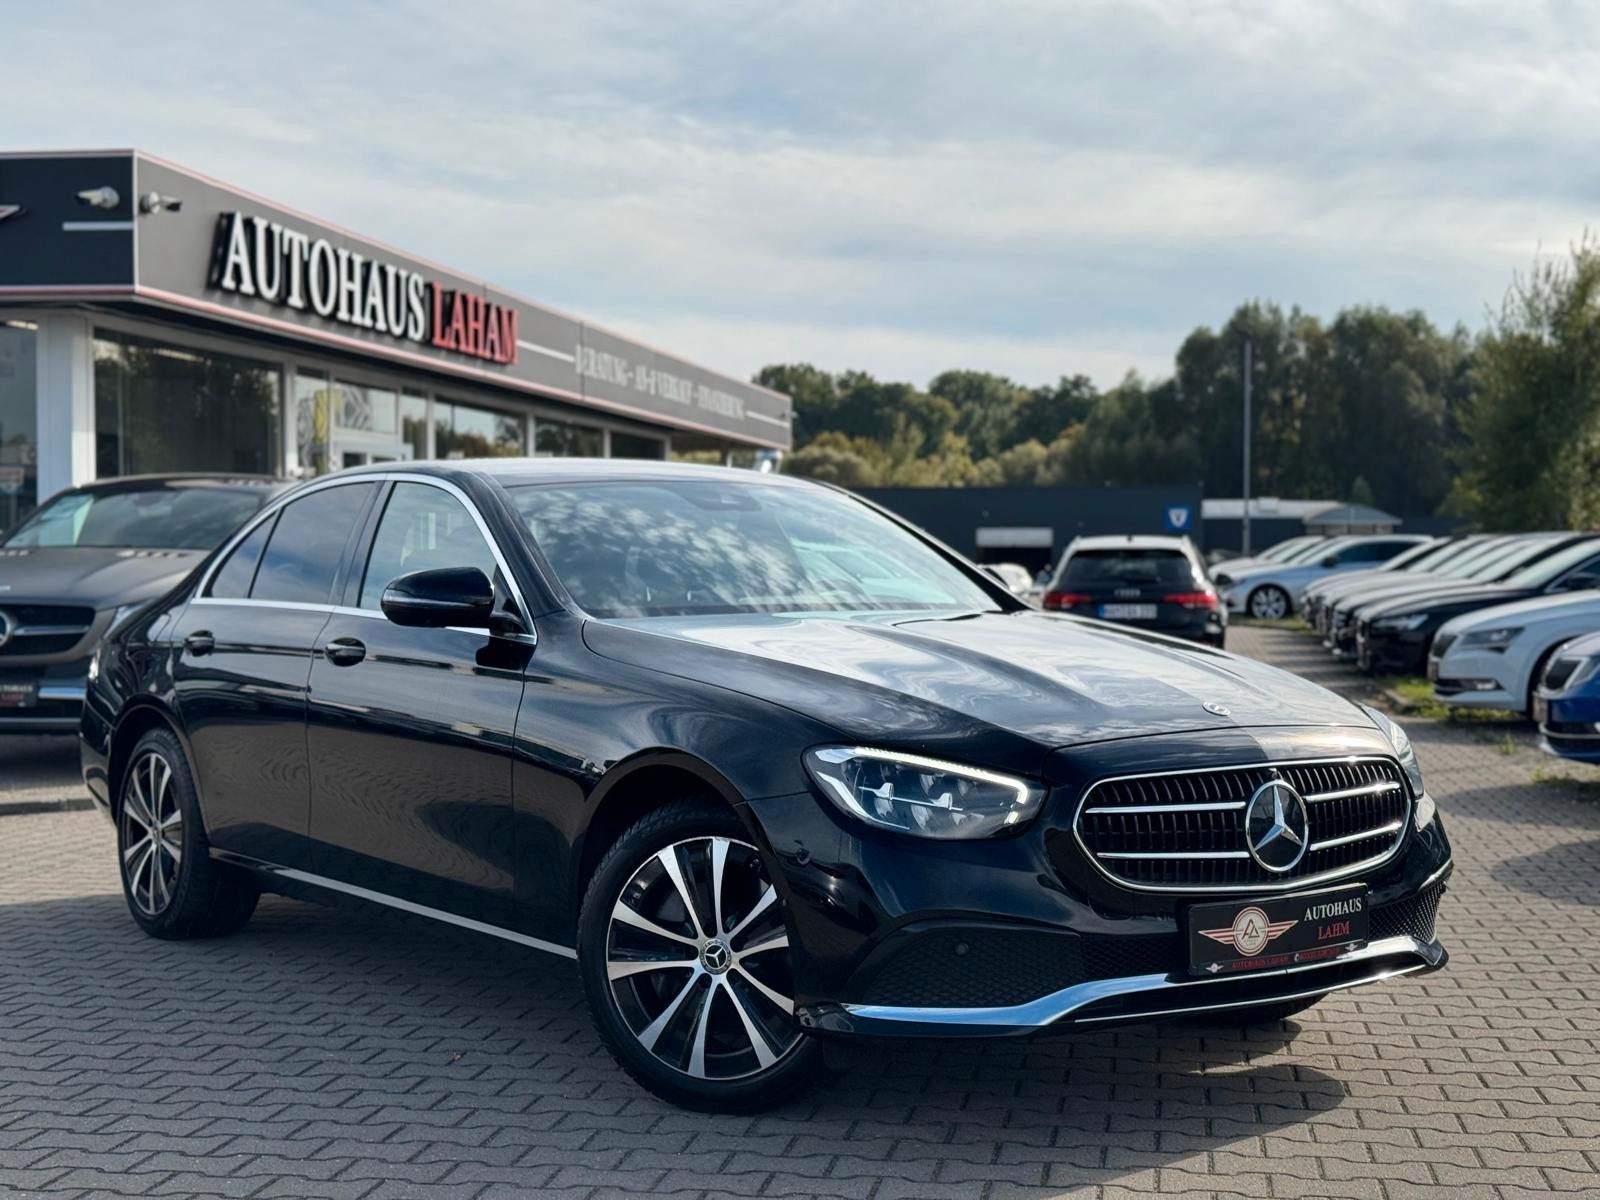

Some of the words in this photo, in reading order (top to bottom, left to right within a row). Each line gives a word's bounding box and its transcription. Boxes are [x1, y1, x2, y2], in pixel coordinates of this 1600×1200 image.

[219, 210, 426, 342] AUTOHAUS
[432, 280, 520, 365] LAHAM
[1304, 898, 1361, 921] AUTOHAUS
